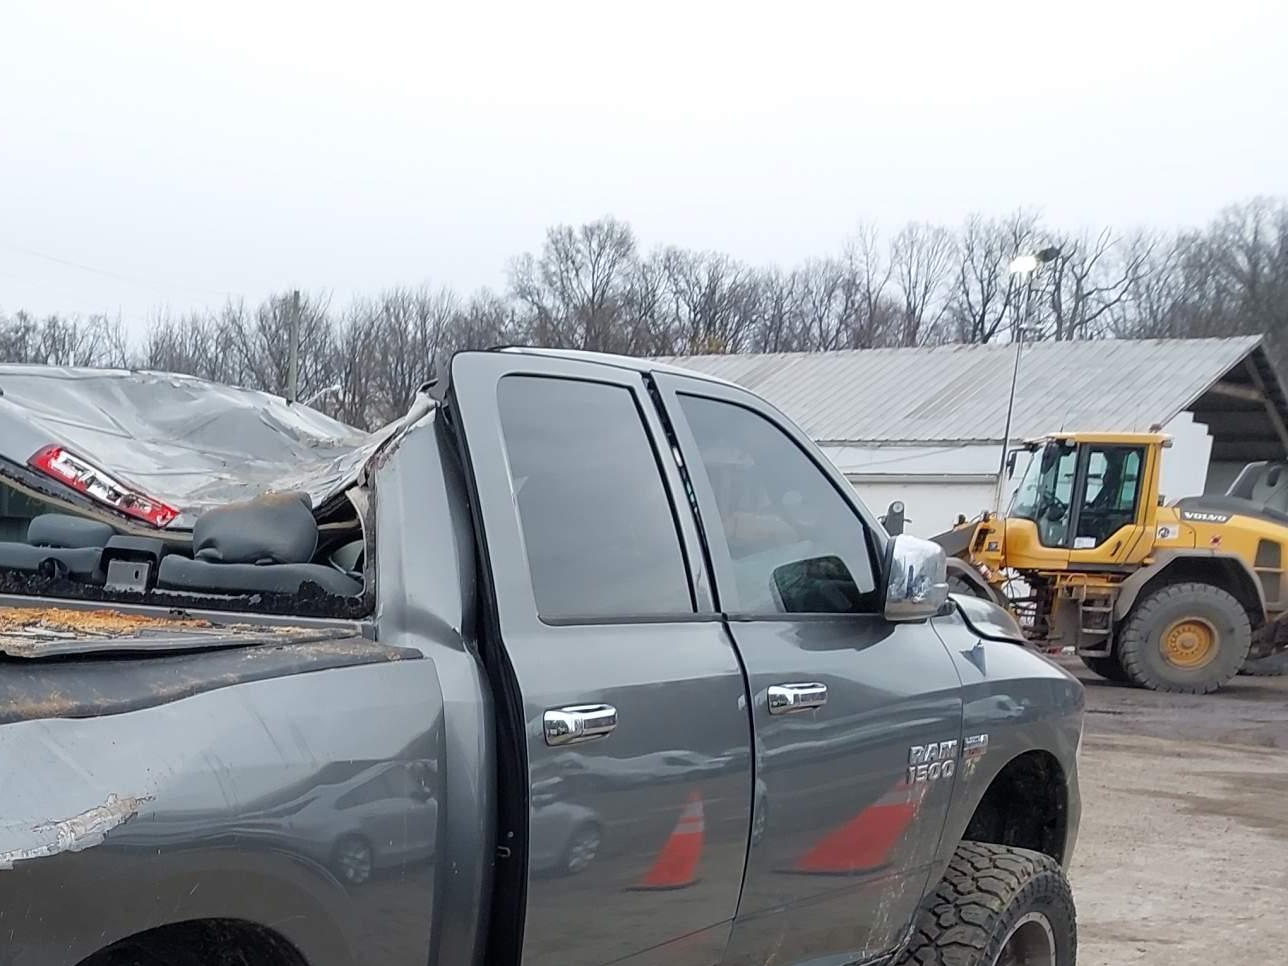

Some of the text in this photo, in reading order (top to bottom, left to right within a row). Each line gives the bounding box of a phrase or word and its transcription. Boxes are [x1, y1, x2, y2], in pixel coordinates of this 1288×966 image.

[1183, 511, 1227, 522] VOLVO
[908, 739, 958, 763] RAM
[907, 760, 955, 784] 1500
